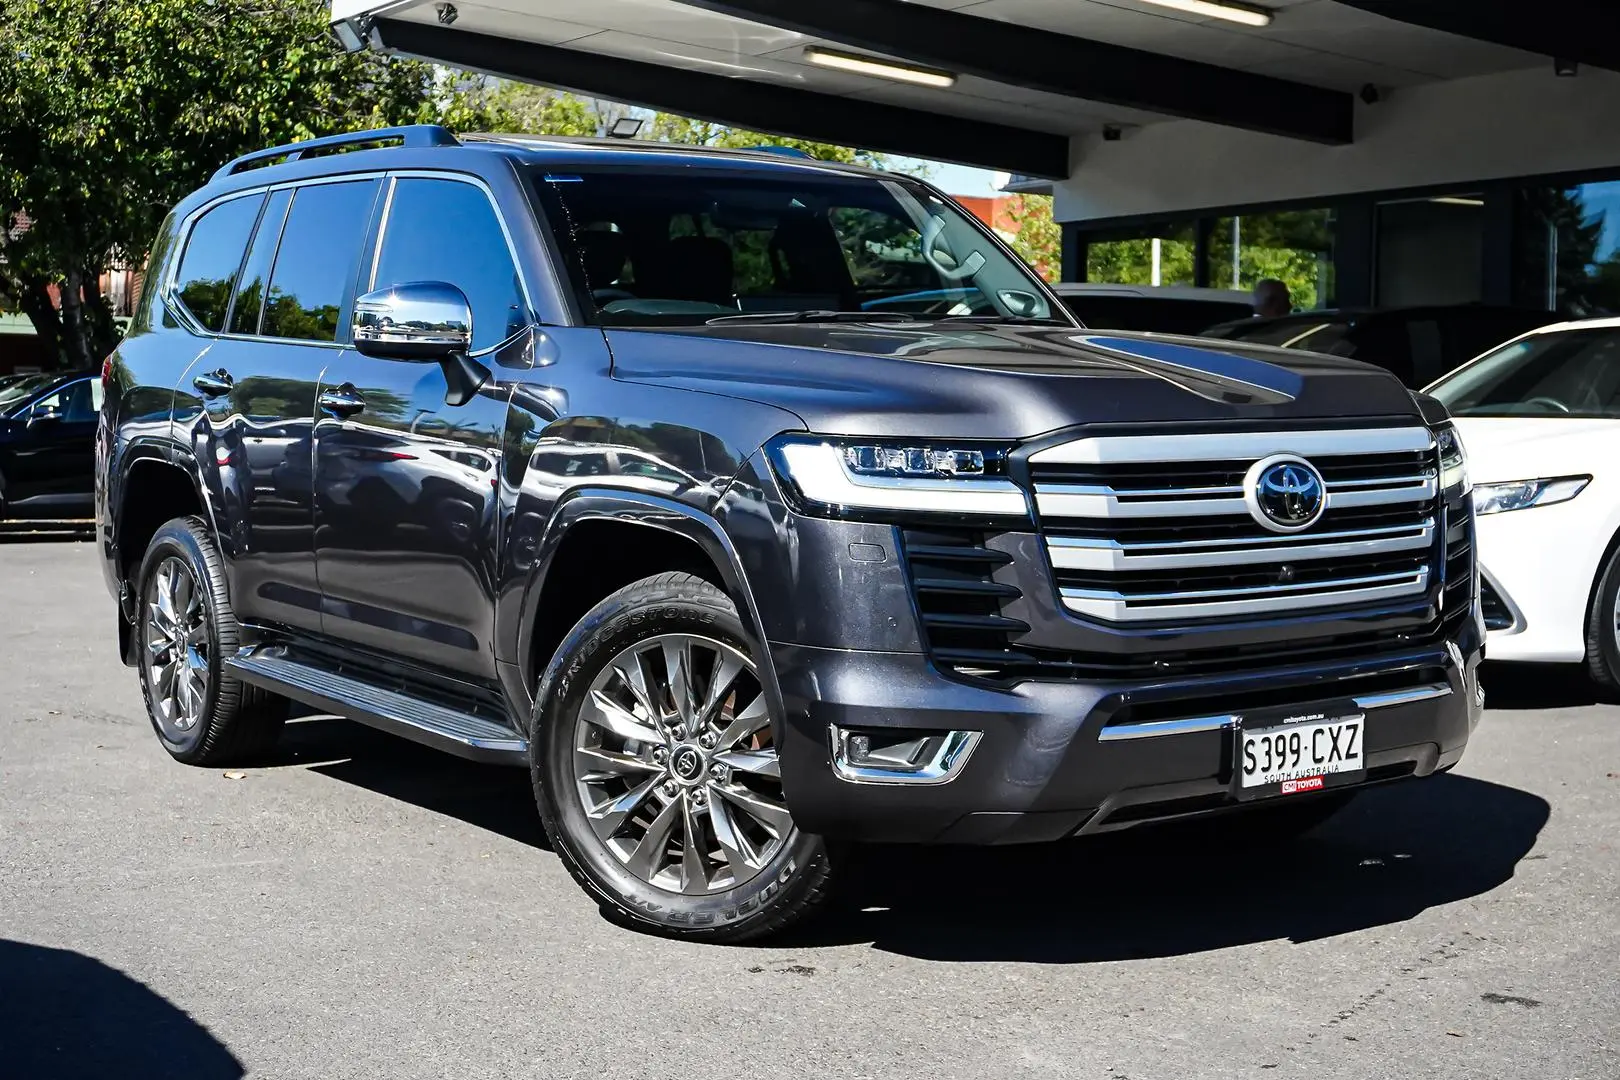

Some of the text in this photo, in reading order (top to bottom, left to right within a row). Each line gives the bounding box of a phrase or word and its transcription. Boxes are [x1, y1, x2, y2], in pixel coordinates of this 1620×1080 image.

[556, 606, 716, 702] BRIDGESTONE
[1264, 764, 1340, 784] SOUTH AUSTRALIA
[1297, 779, 1323, 789] TOYOTA
